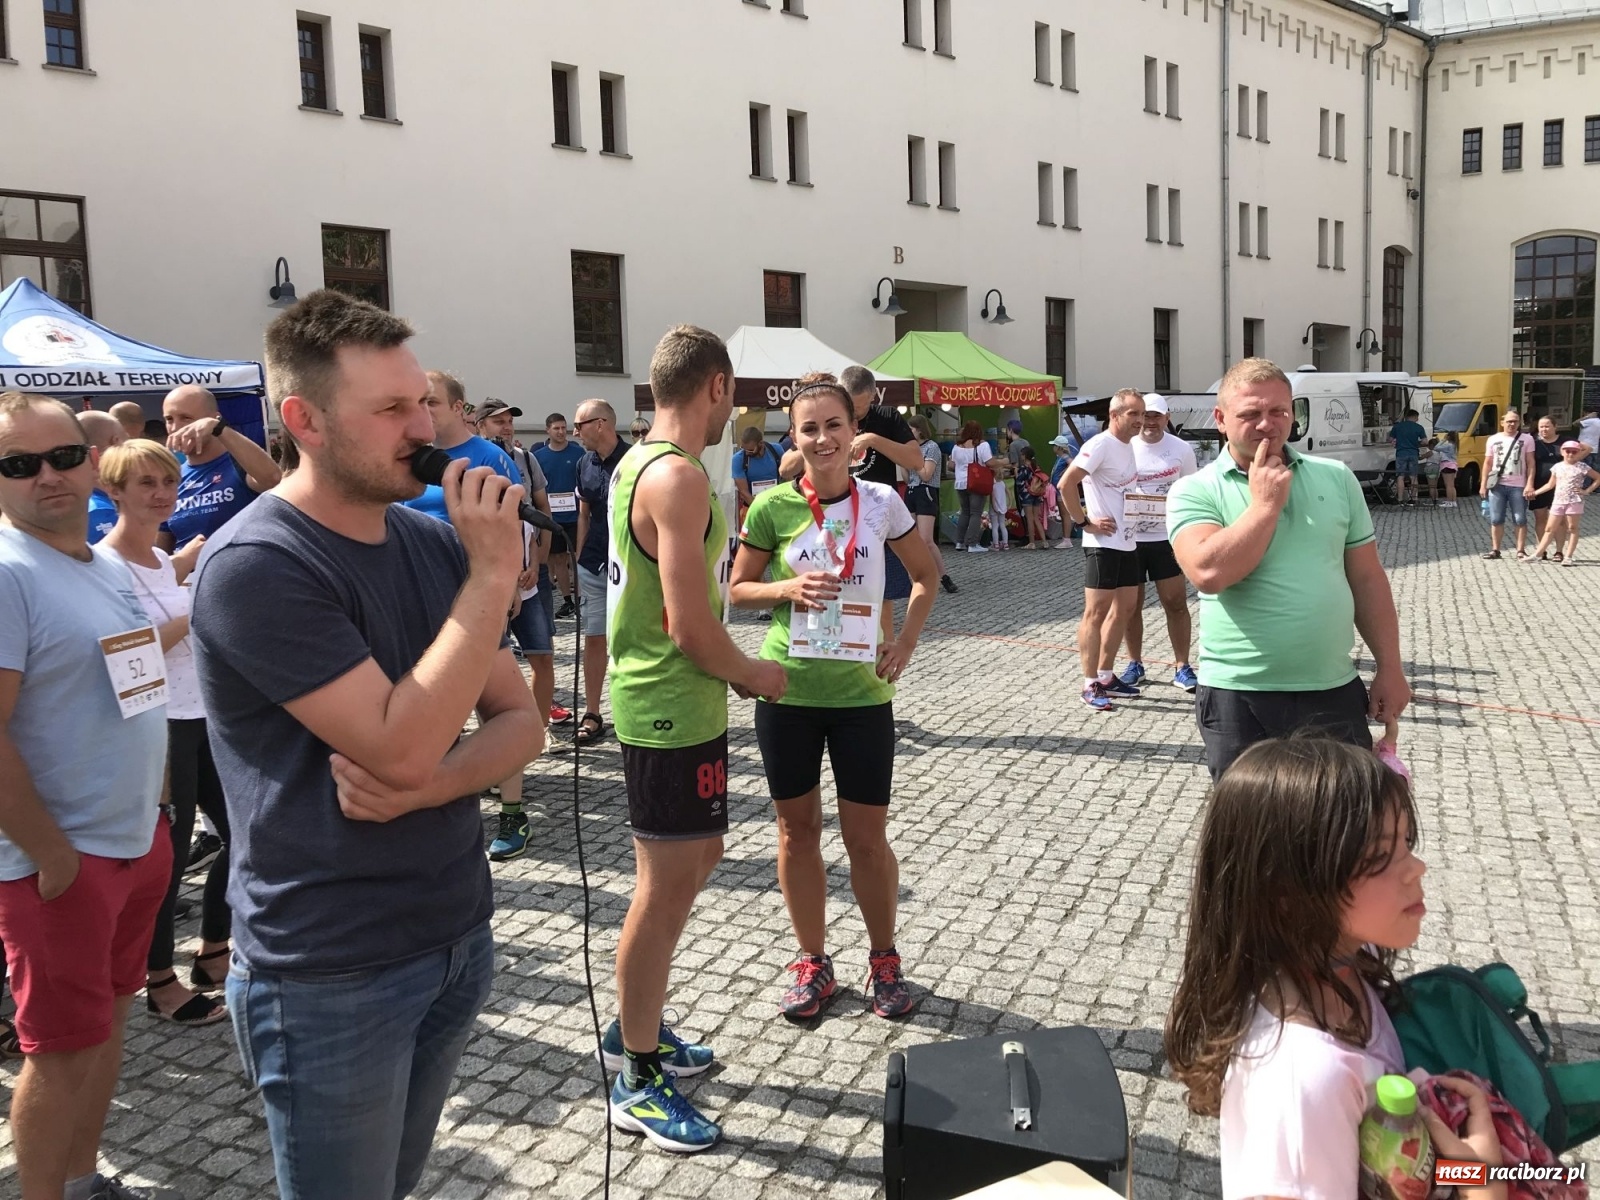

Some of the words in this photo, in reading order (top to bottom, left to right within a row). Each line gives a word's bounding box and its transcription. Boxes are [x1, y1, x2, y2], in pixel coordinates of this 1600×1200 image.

[893, 246, 904, 264] B
[15, 371, 111, 388] ODDZIAŁ
[115, 370, 222, 386] TERENOWY
[941, 386, 993, 401] SORBETY
[995, 386, 1042, 401] LODOWE
[201, 506, 219, 515] TEAM
[799, 546, 869, 561] AKTNI
[128, 657, 147, 679] 52
[697, 759, 726, 799] 88
